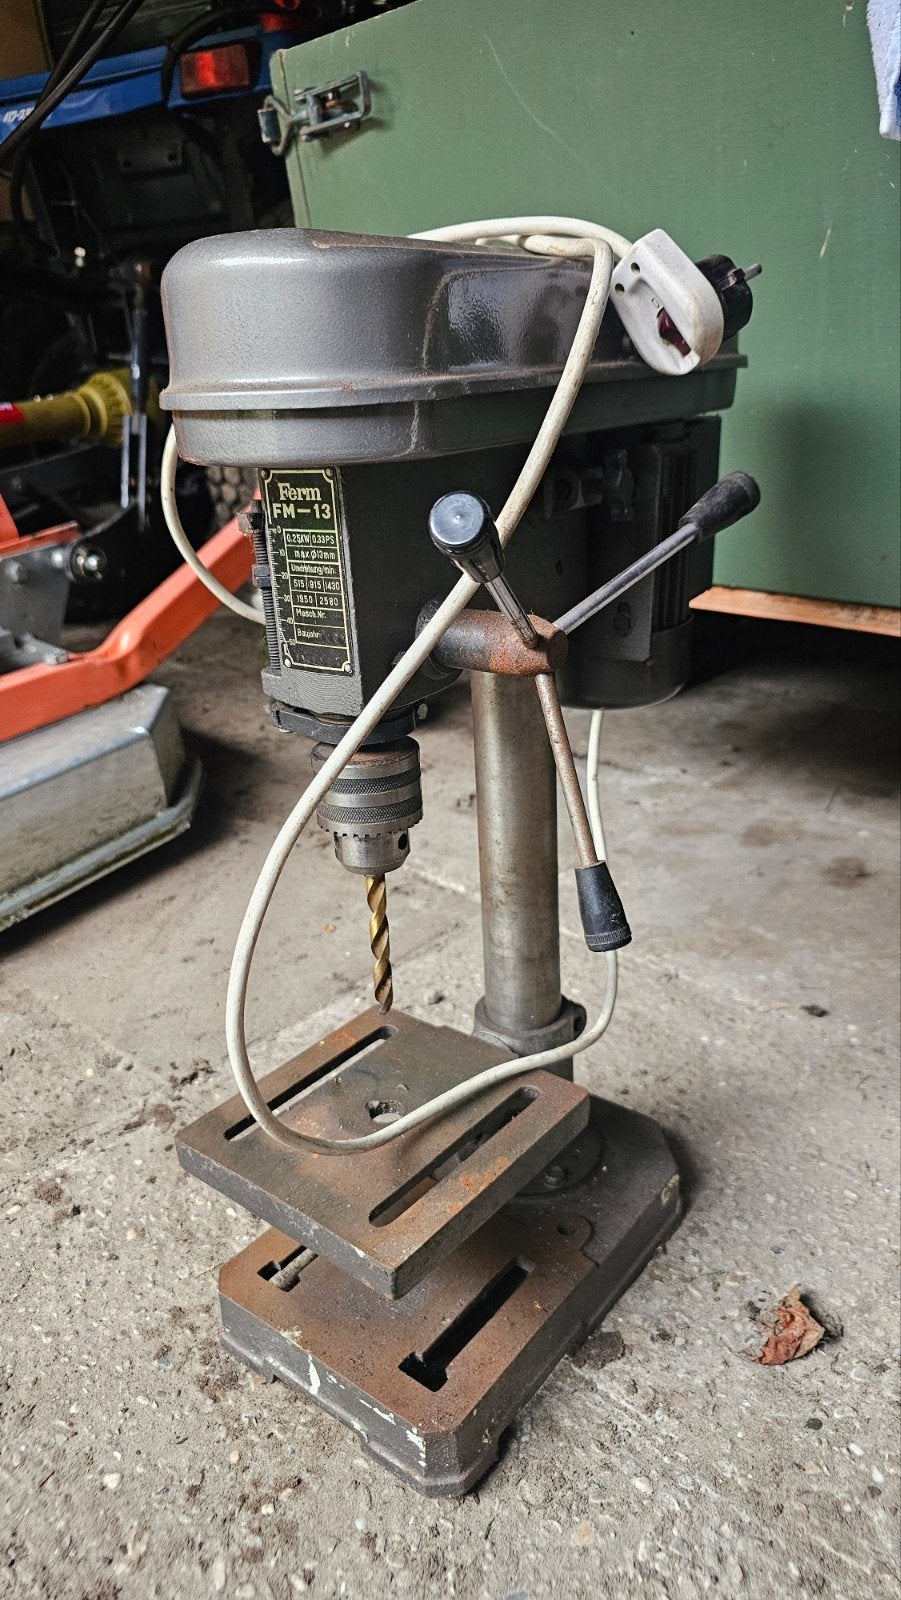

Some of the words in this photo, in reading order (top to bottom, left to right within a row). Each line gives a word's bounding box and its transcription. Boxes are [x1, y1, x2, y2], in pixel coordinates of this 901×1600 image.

[277, 482, 322, 501] Ferm
[272, 502, 332, 519] FM-13
[311, 534, 336, 545] 0.33PS
[294, 550, 310, 560] max
[309, 580, 321, 590] 915
[297, 595, 313, 604] 1950
[319, 597, 338, 606] 2580
